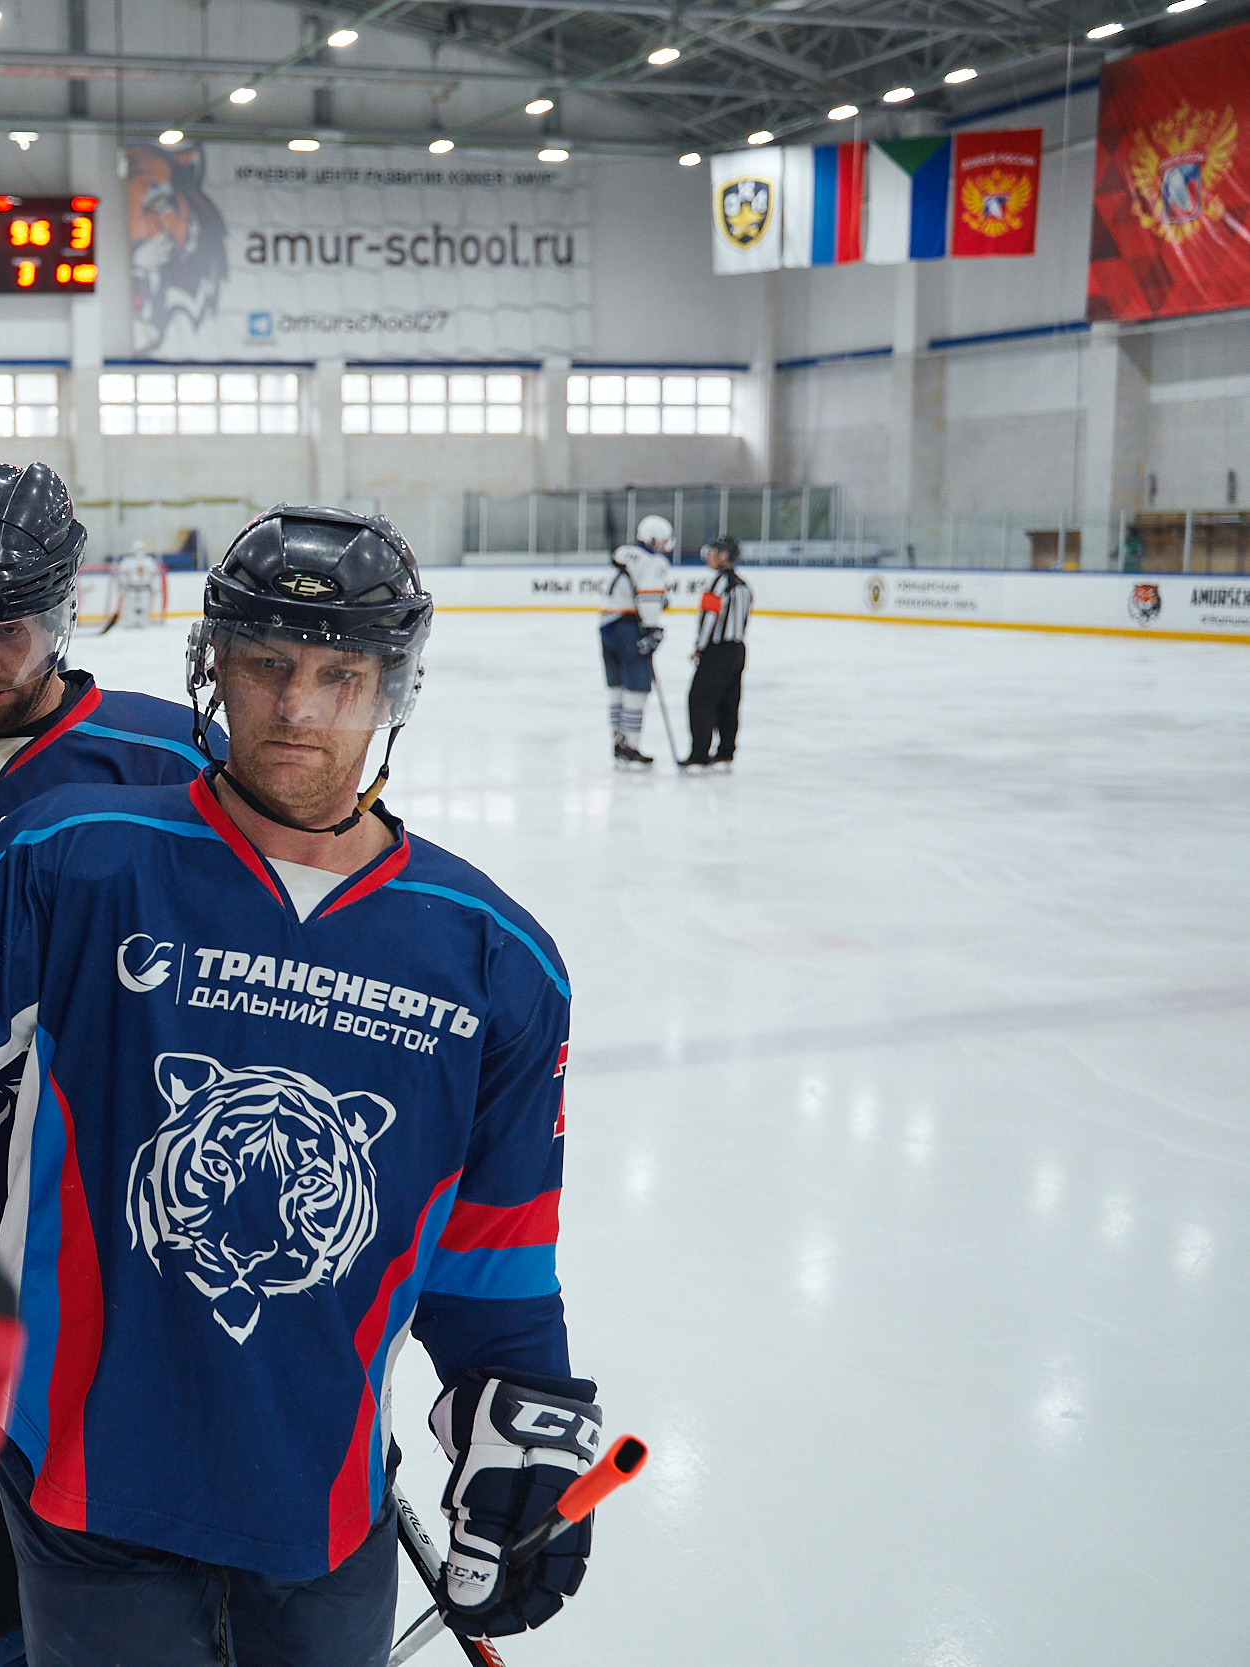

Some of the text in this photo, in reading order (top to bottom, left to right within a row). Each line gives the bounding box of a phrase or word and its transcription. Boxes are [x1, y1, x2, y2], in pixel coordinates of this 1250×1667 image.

[69, 216, 93, 250] 3
[245, 223, 575, 268] amur-school.ru
[187, 986, 440, 1056] ДАЛЬНИЙ ВОСТОК
[193, 947, 480, 1039] ТРАНСНЕФТЬ
